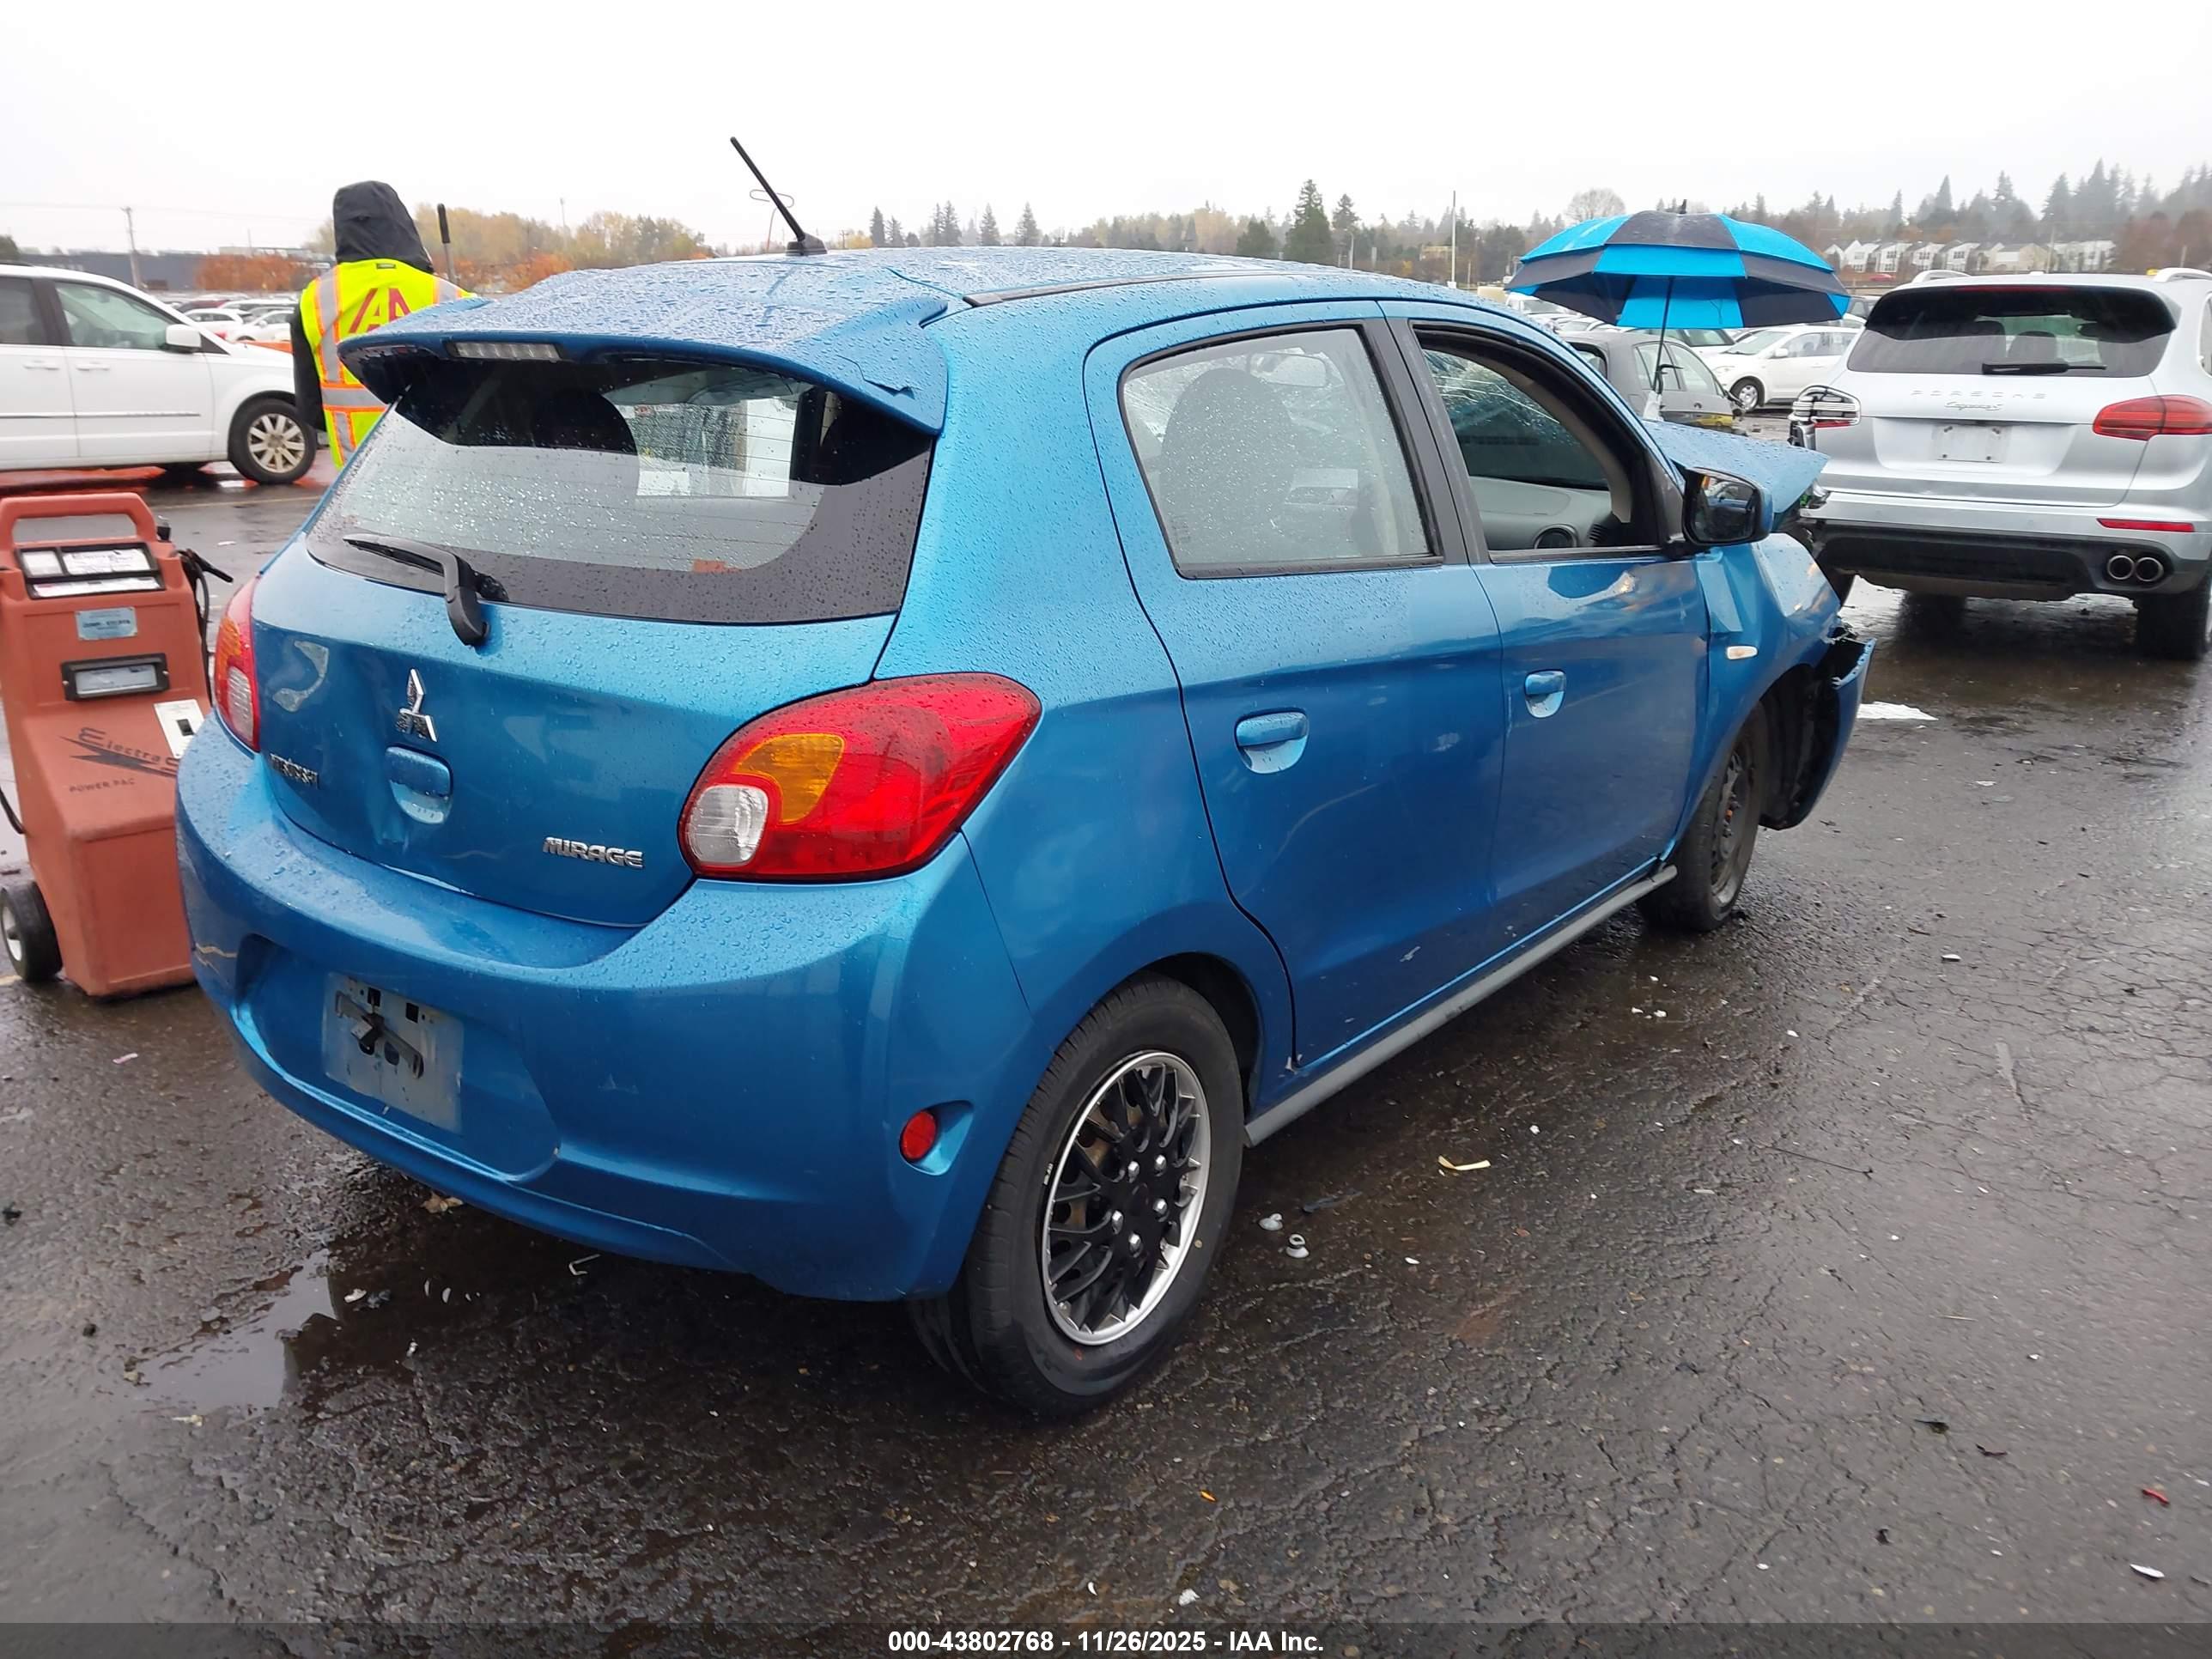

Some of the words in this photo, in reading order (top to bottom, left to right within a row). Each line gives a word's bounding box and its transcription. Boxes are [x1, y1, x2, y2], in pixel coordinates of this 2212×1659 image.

[69, 781, 111, 793] POWER
[112, 778, 136, 787] PAC
[543, 836, 644, 868] MIRAGE
